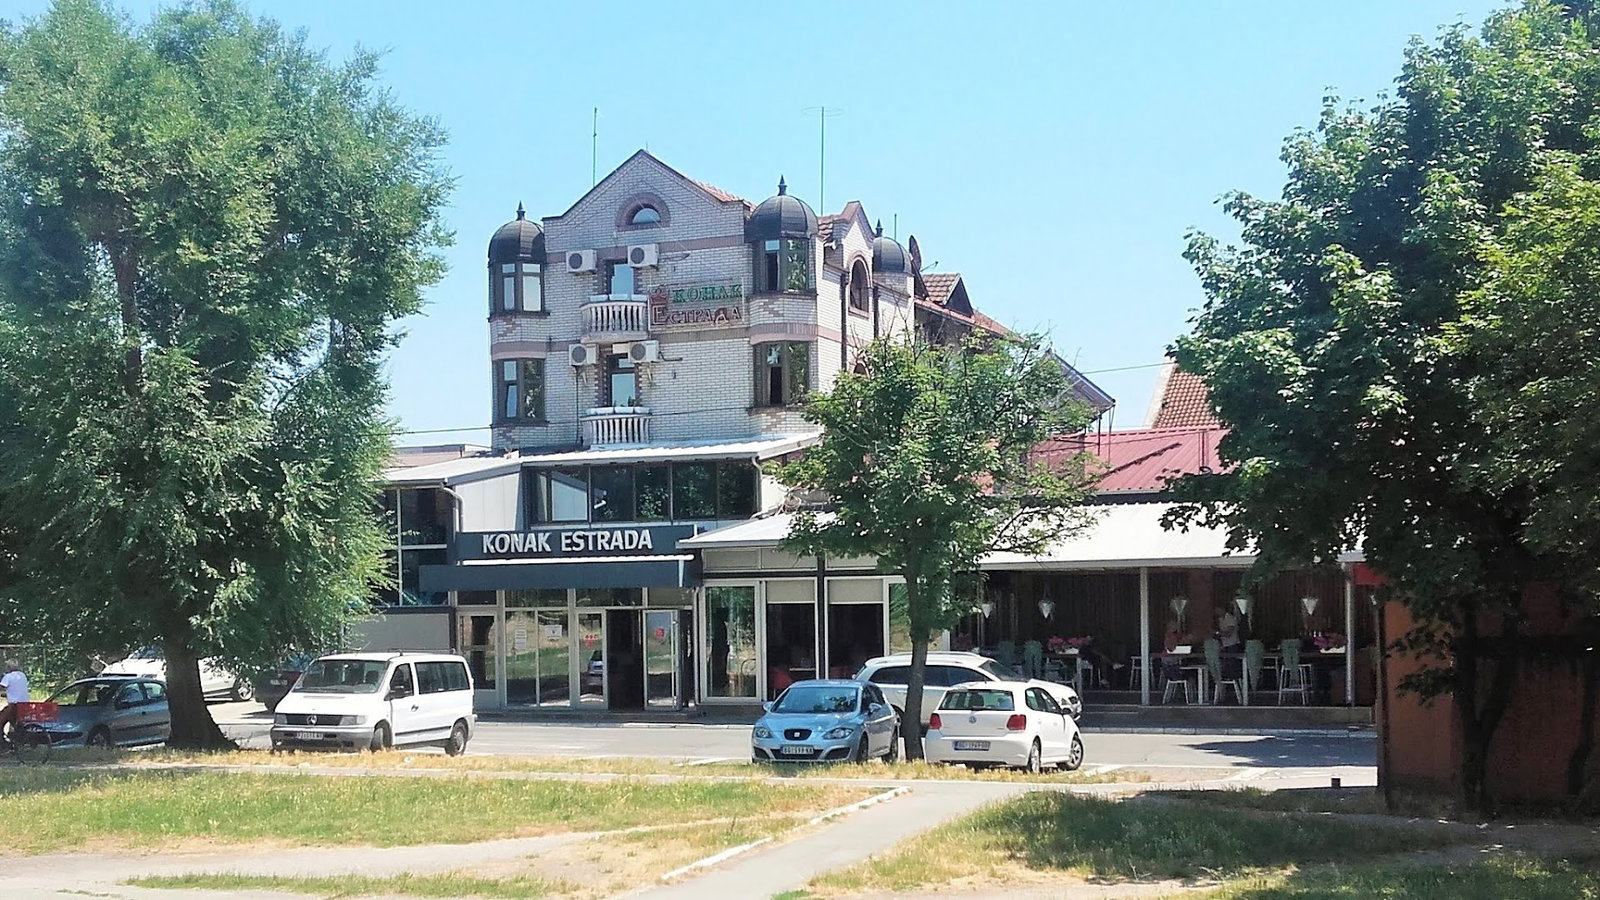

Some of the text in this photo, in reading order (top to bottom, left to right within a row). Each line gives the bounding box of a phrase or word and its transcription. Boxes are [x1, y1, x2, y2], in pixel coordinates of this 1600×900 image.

[672, 284, 743, 303] КОНАК
[482, 528, 653, 554] KONAK ESTRADA
